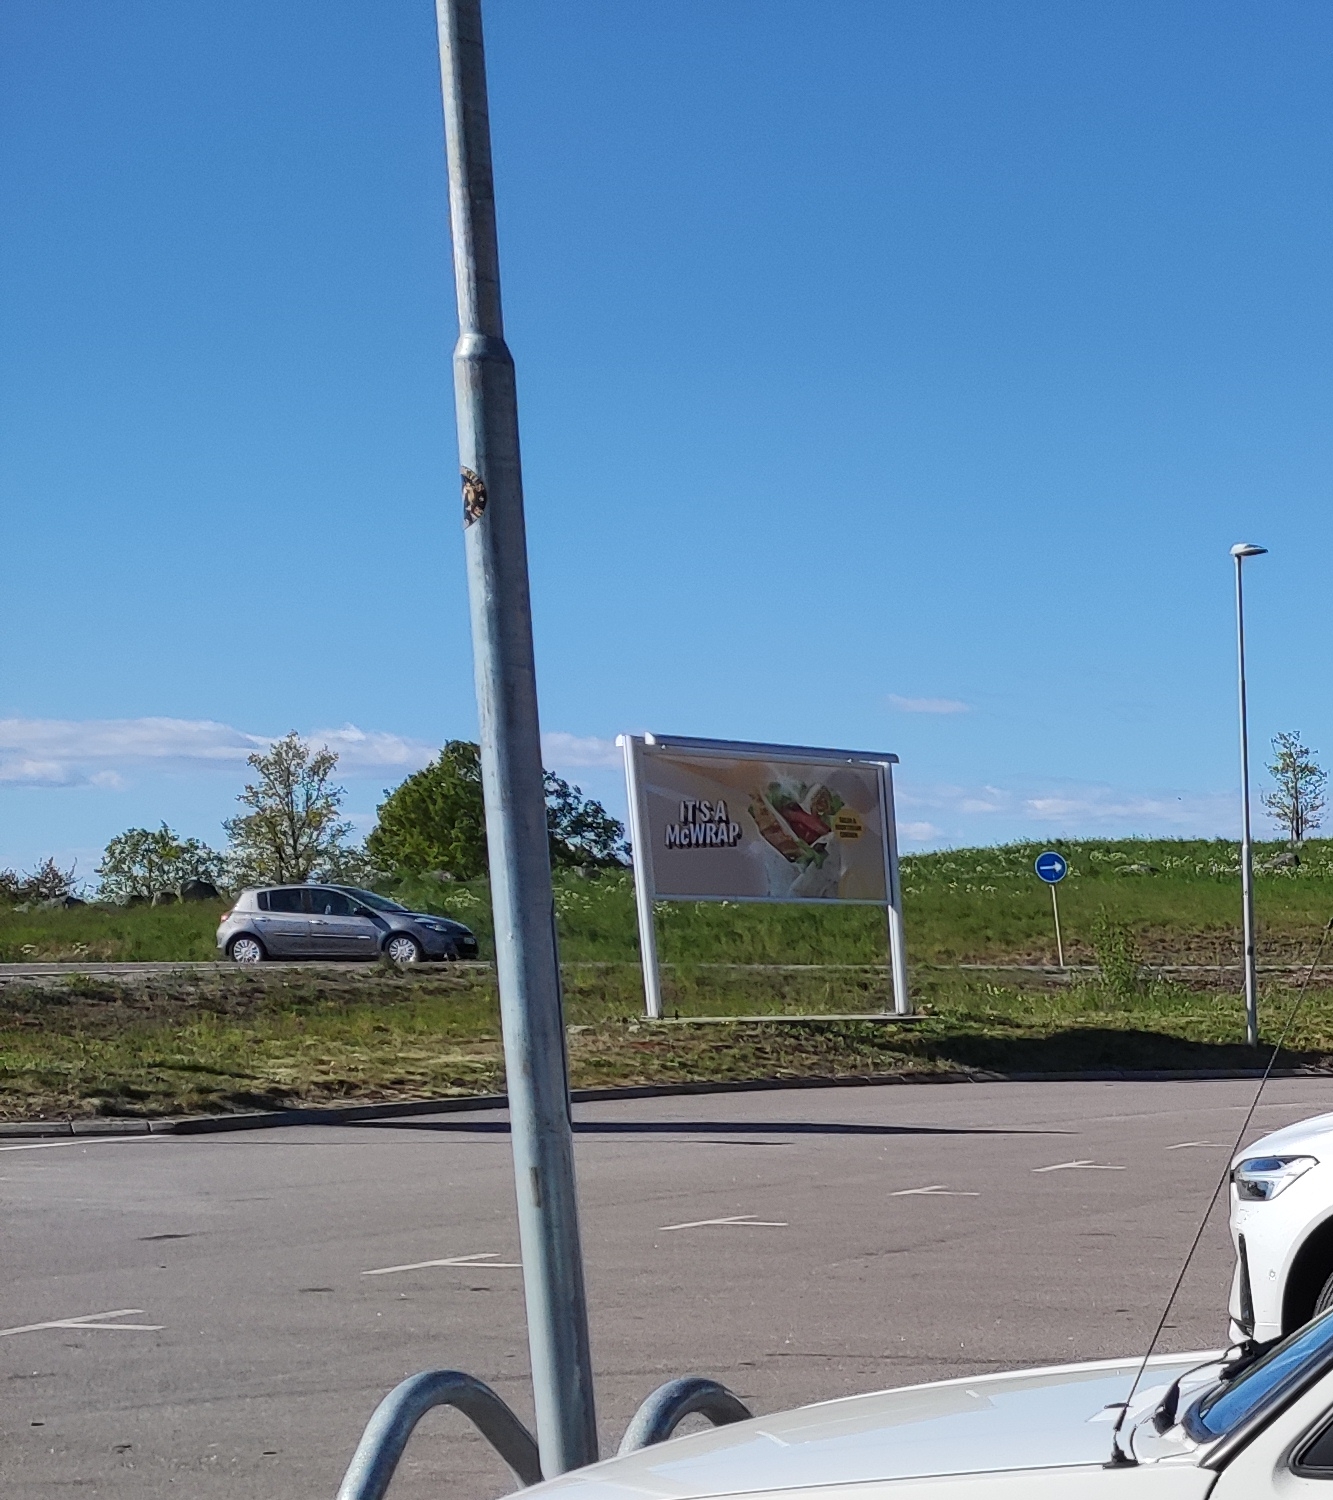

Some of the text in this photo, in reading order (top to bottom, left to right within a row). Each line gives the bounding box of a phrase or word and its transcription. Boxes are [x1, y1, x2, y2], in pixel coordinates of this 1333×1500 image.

[680, 800, 730, 825] IT'S A
[665, 822, 743, 850] McWRAP
